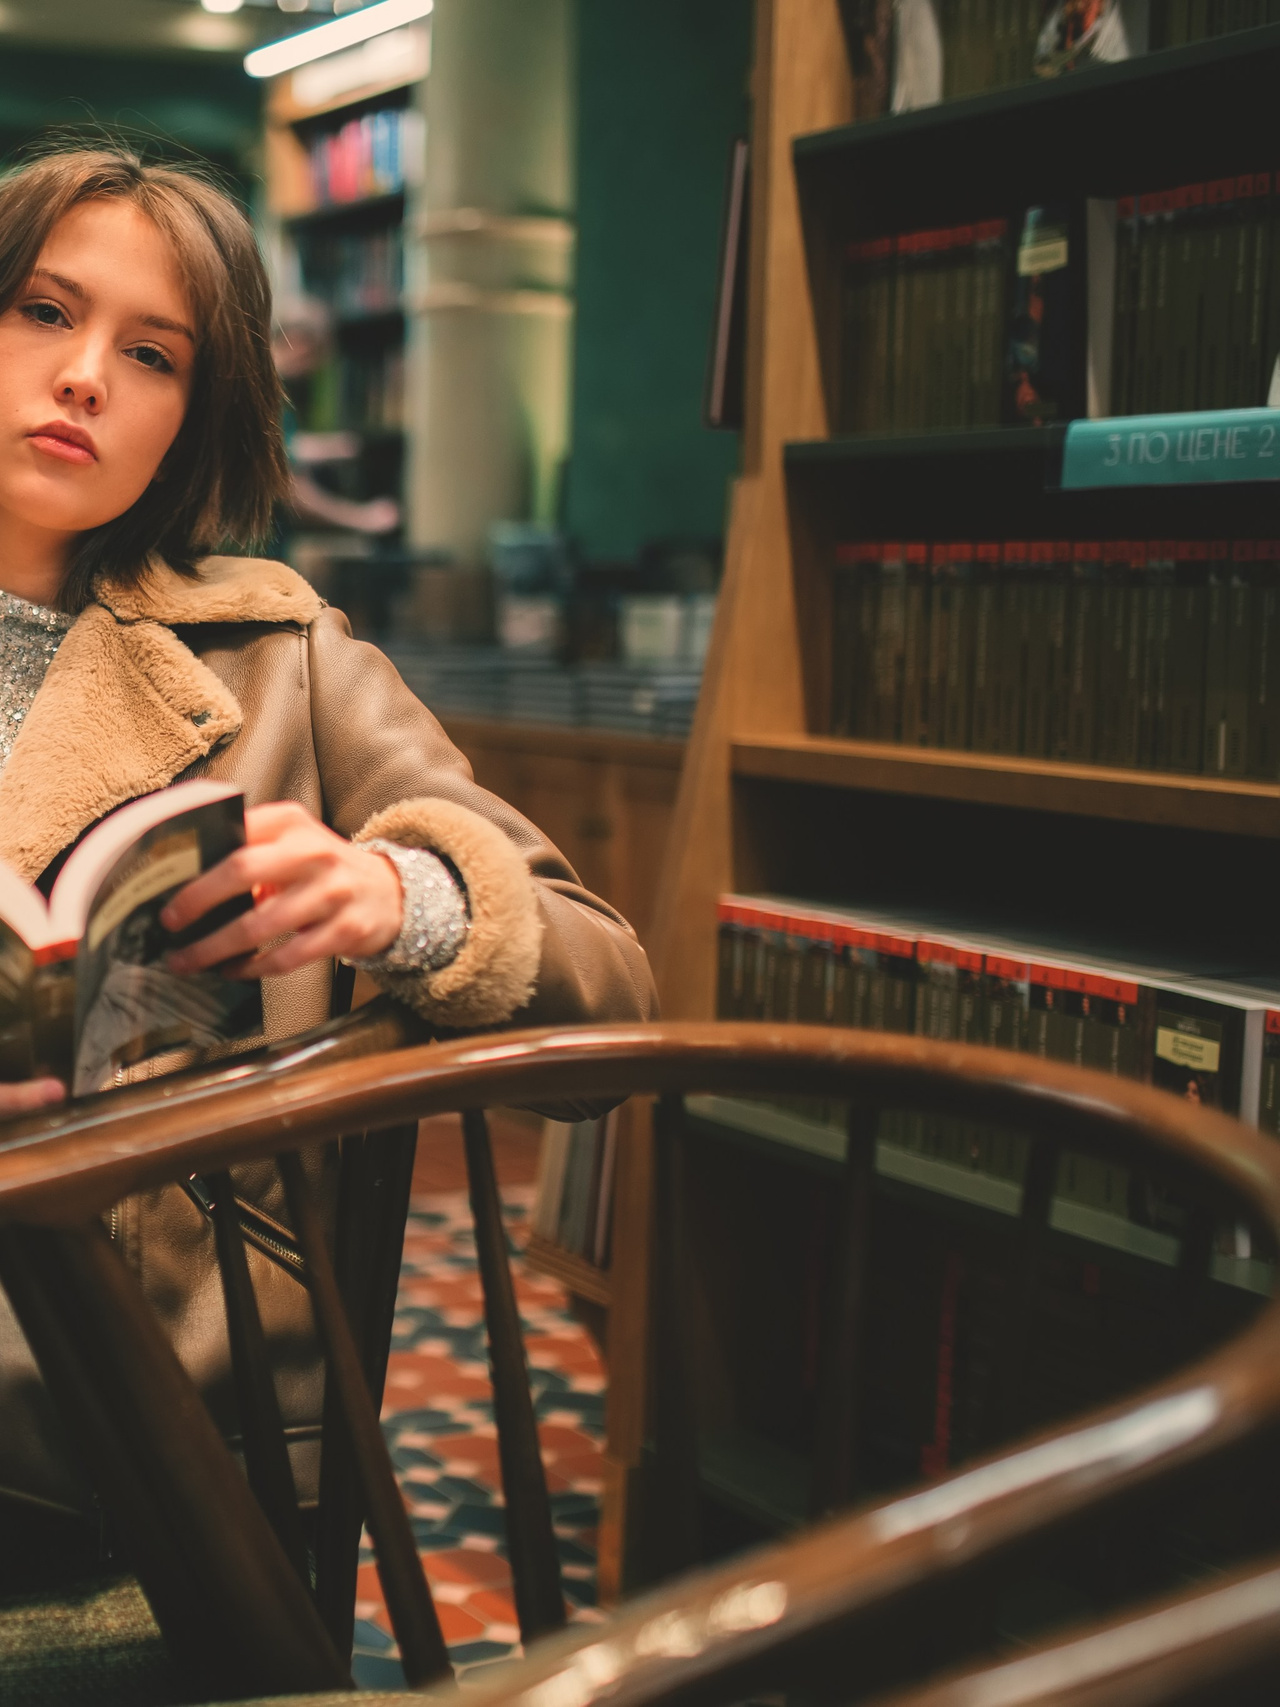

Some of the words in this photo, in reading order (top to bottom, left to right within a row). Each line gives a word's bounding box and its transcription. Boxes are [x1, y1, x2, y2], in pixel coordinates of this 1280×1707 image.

[1103, 434, 1121, 466] 3
[1128, 431, 1170, 464] ПО
[1177, 427, 1250, 464] ЦЕНЕ
